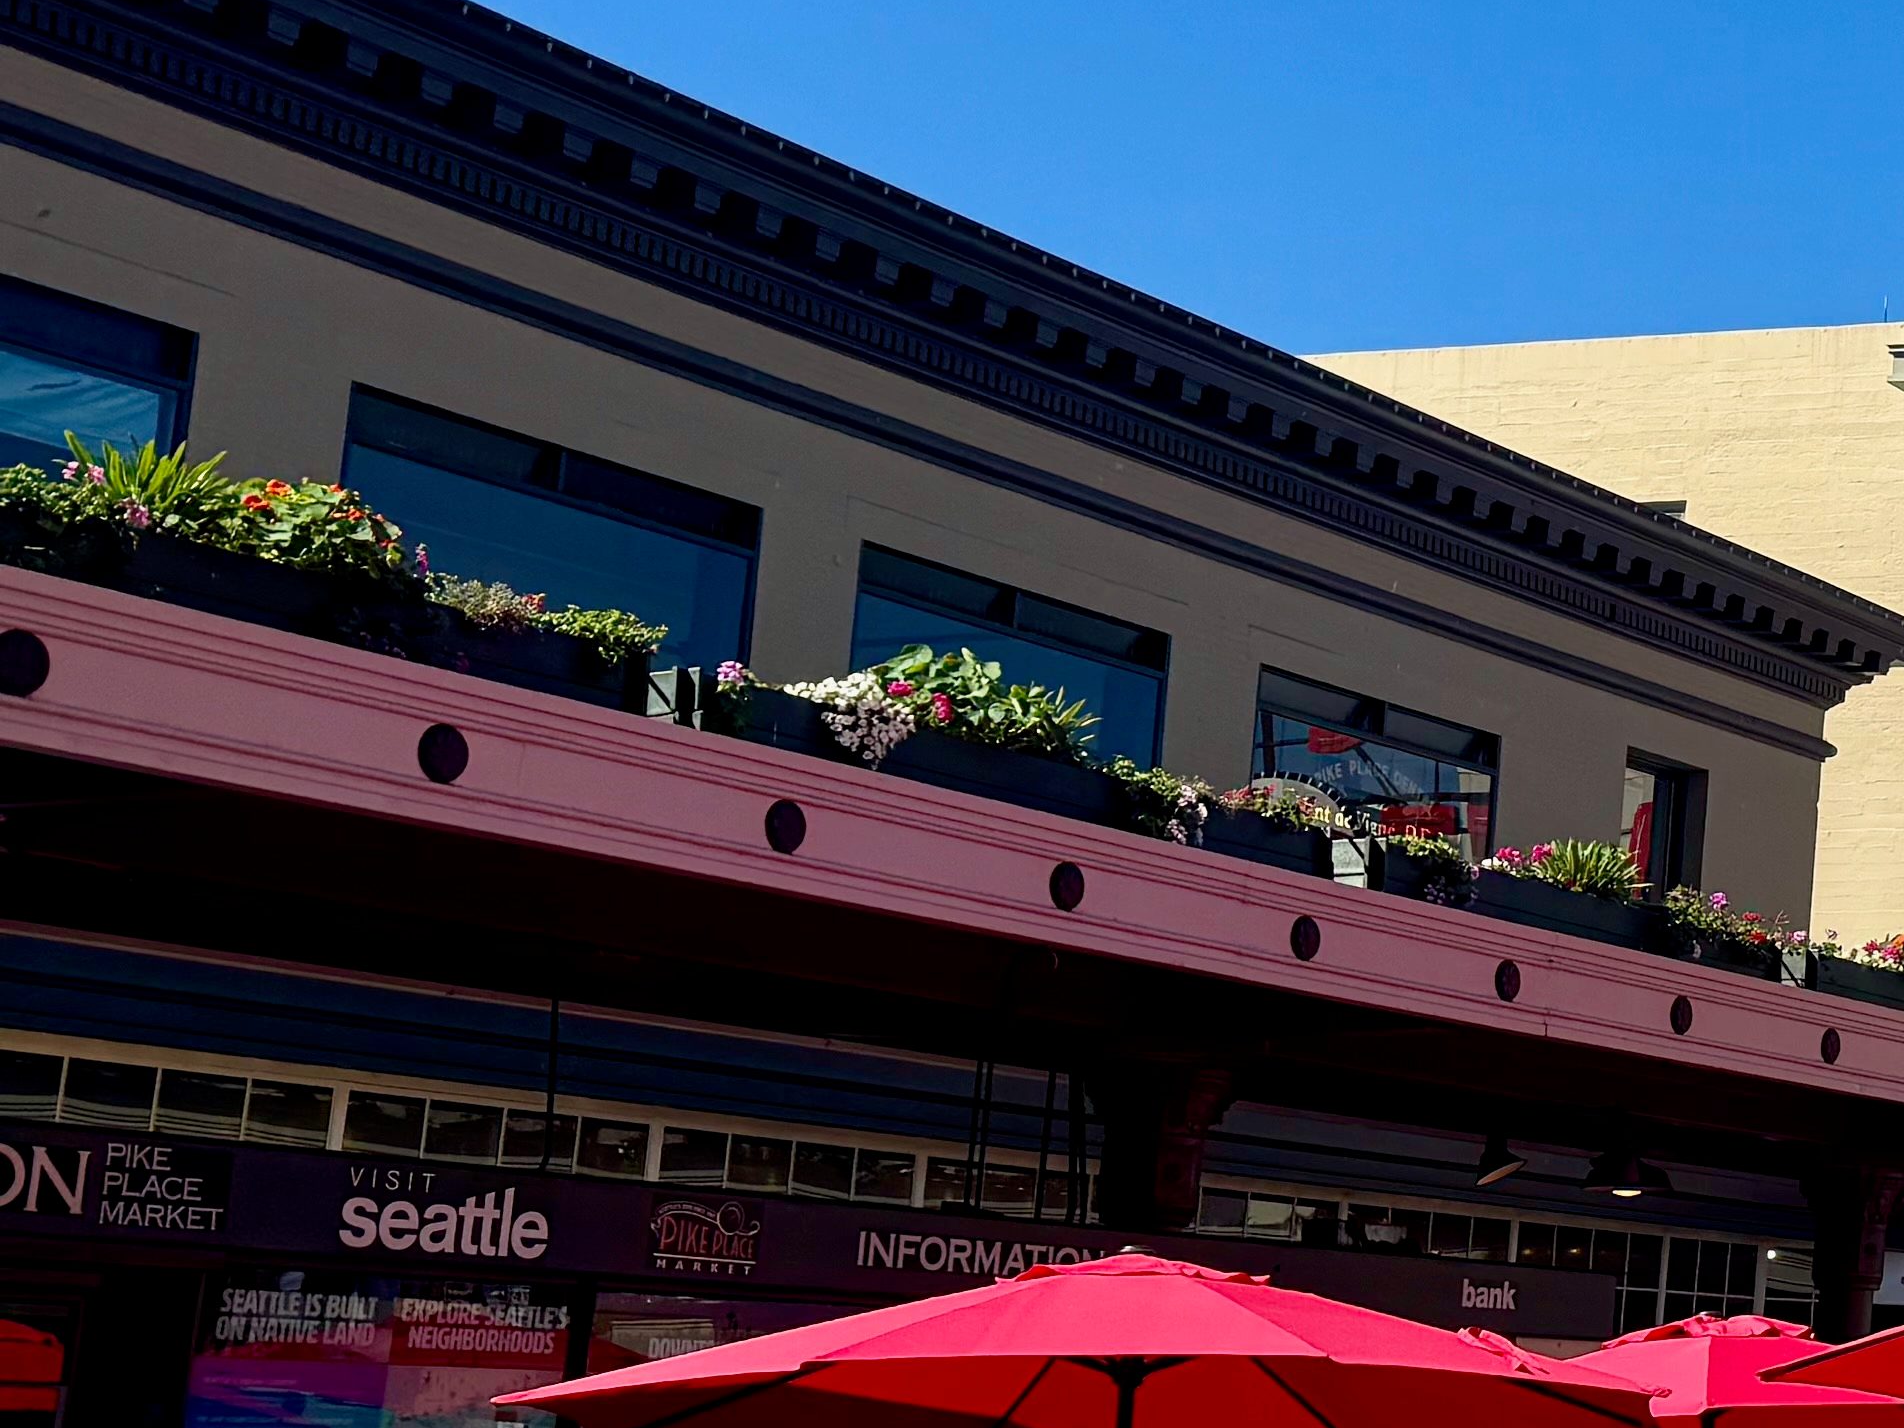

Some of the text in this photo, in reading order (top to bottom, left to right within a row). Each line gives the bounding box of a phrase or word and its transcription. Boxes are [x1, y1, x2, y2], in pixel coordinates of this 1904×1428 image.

[105, 1142, 174, 1172] PIKE
[101, 1171, 204, 1202] PLACE
[349, 1166, 437, 1193] VISIT
[97, 1201, 225, 1232] MARKET
[339, 1186, 549, 1260] seattle
[658, 1215, 756, 1260] PIKE PLACE
[655, 1258, 753, 1277] MARKET
[221, 1287, 379, 1321] SEATTLE IS BUILT
[1461, 1277, 1517, 1310] bank
[400, 1298, 568, 1329] EXPLORE SEATTLE'S
[215, 1315, 376, 1347] ON NATIVE LAND
[407, 1326, 556, 1355] NEIGHBORHOODS
